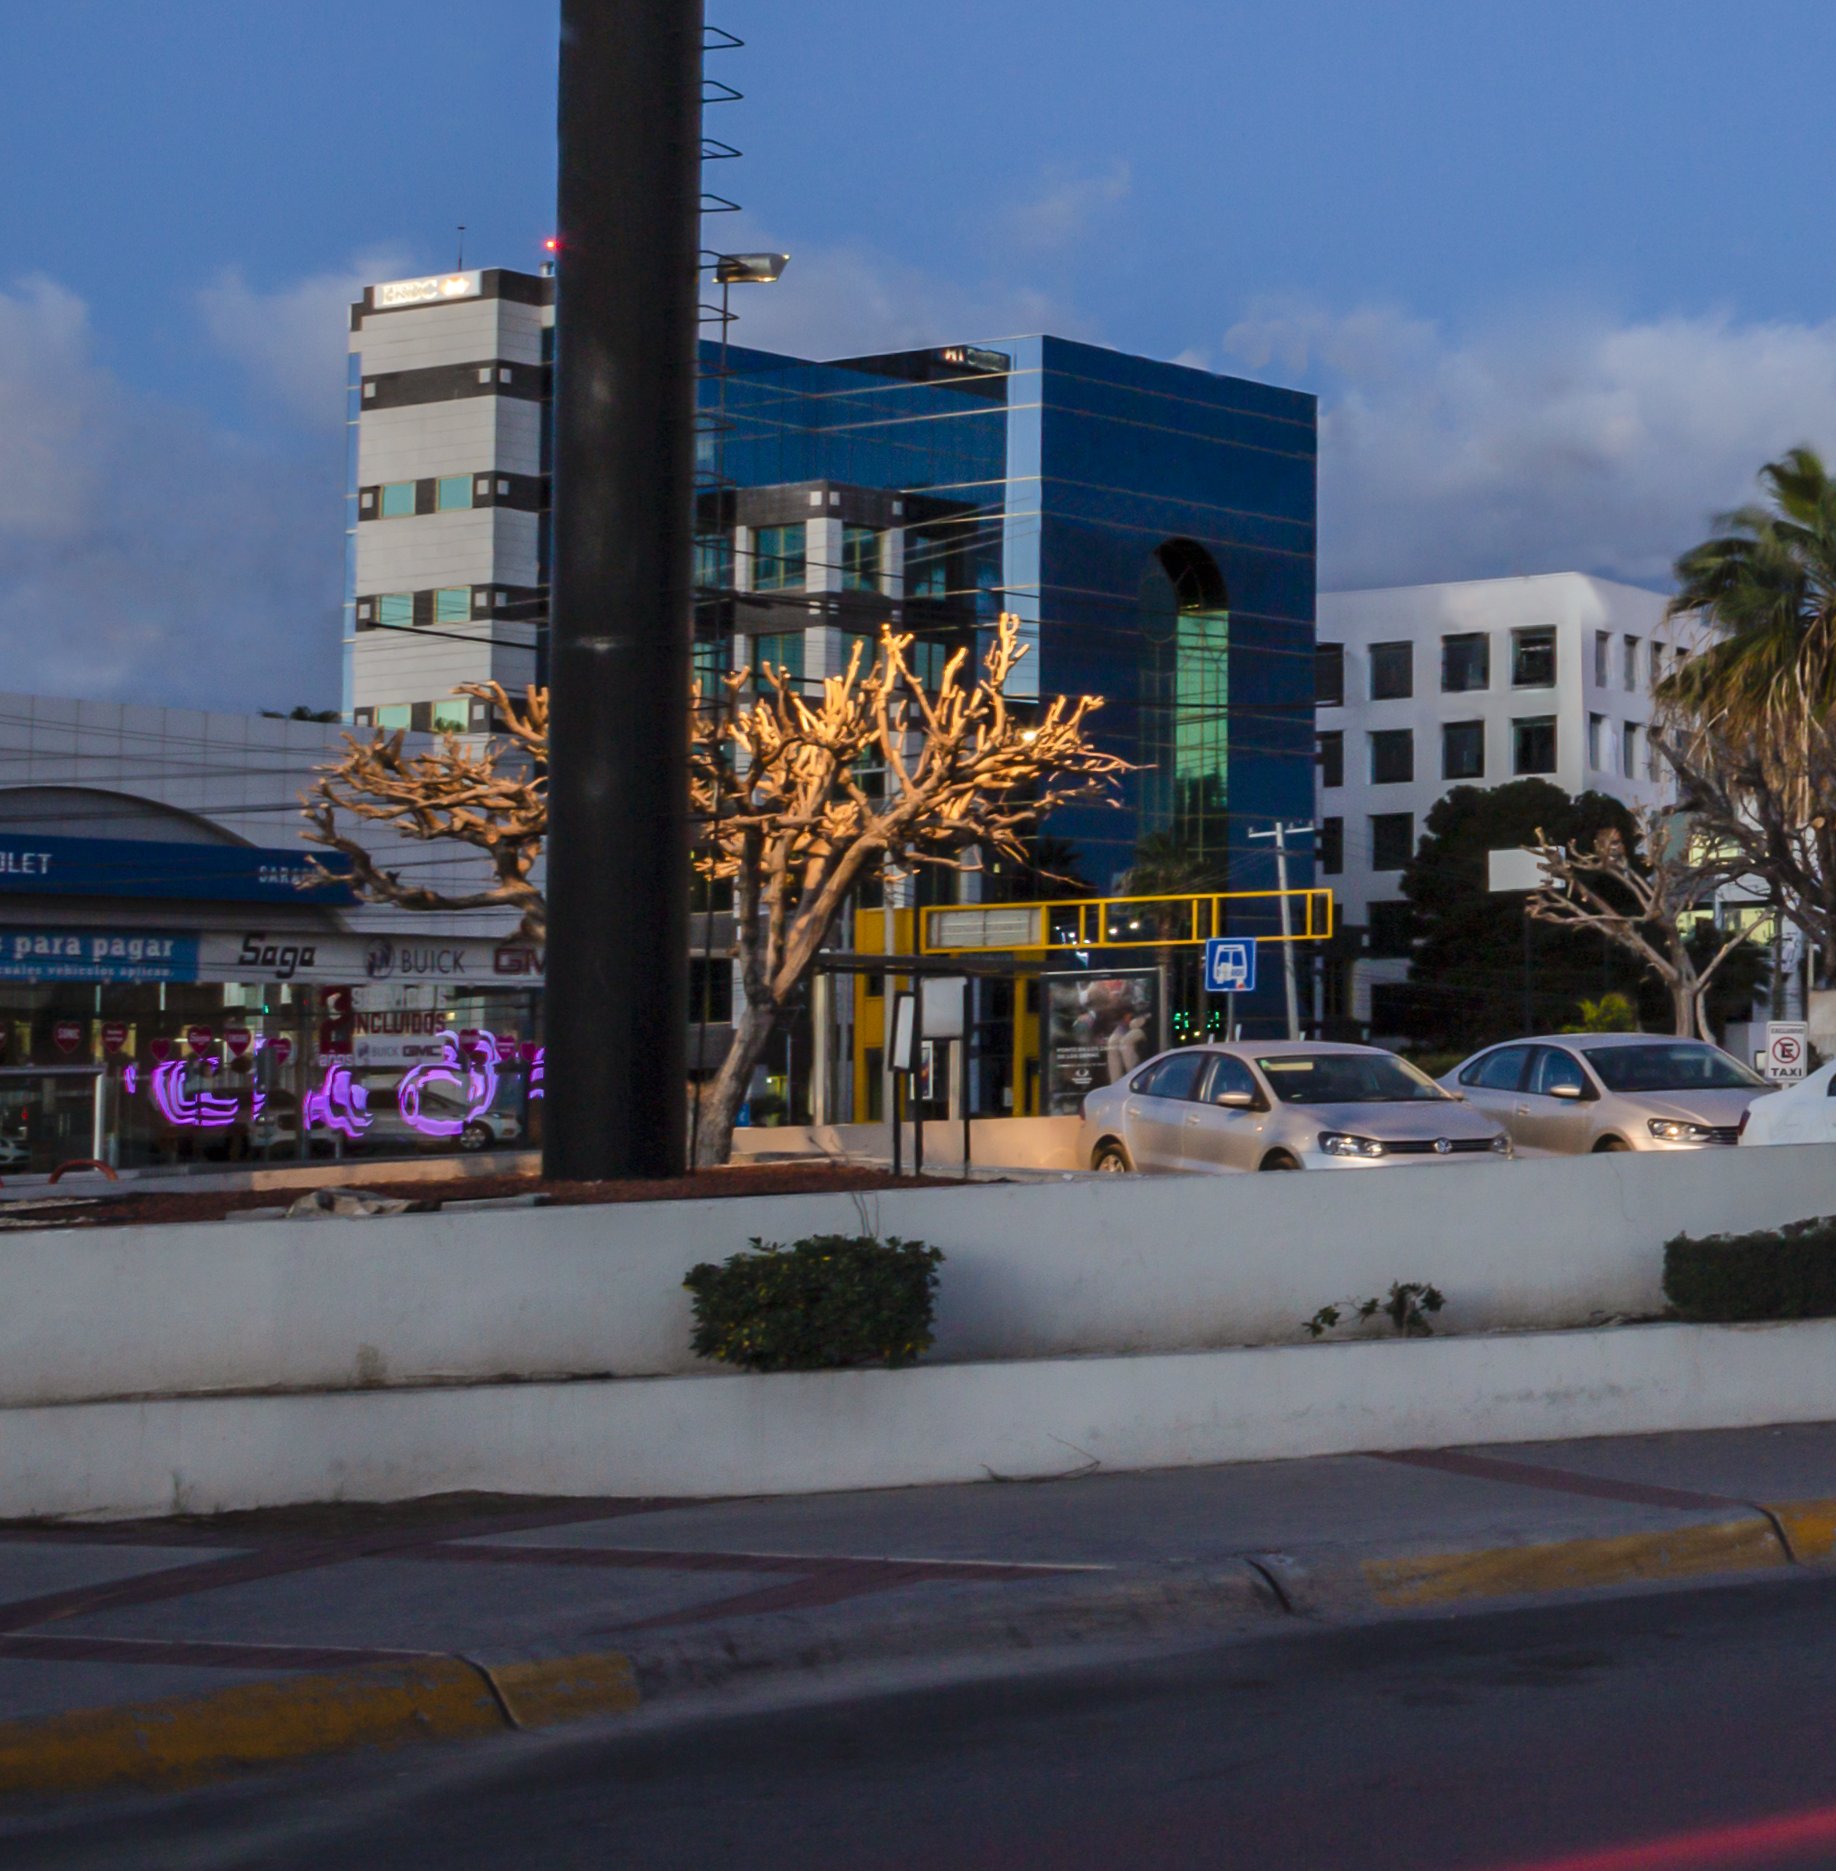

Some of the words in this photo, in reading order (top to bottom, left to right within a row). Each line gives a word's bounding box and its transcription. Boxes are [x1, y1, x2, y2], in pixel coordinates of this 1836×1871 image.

[15, 935, 82, 960] para
[92, 937, 174, 963] pagar
[238, 932, 317, 979] Saga
[401, 949, 466, 974] BUICK
[494, 946, 546, 976] GM
[402, 1045, 442, 1057] GMC
[1770, 1067, 1802, 1076] TAXI
